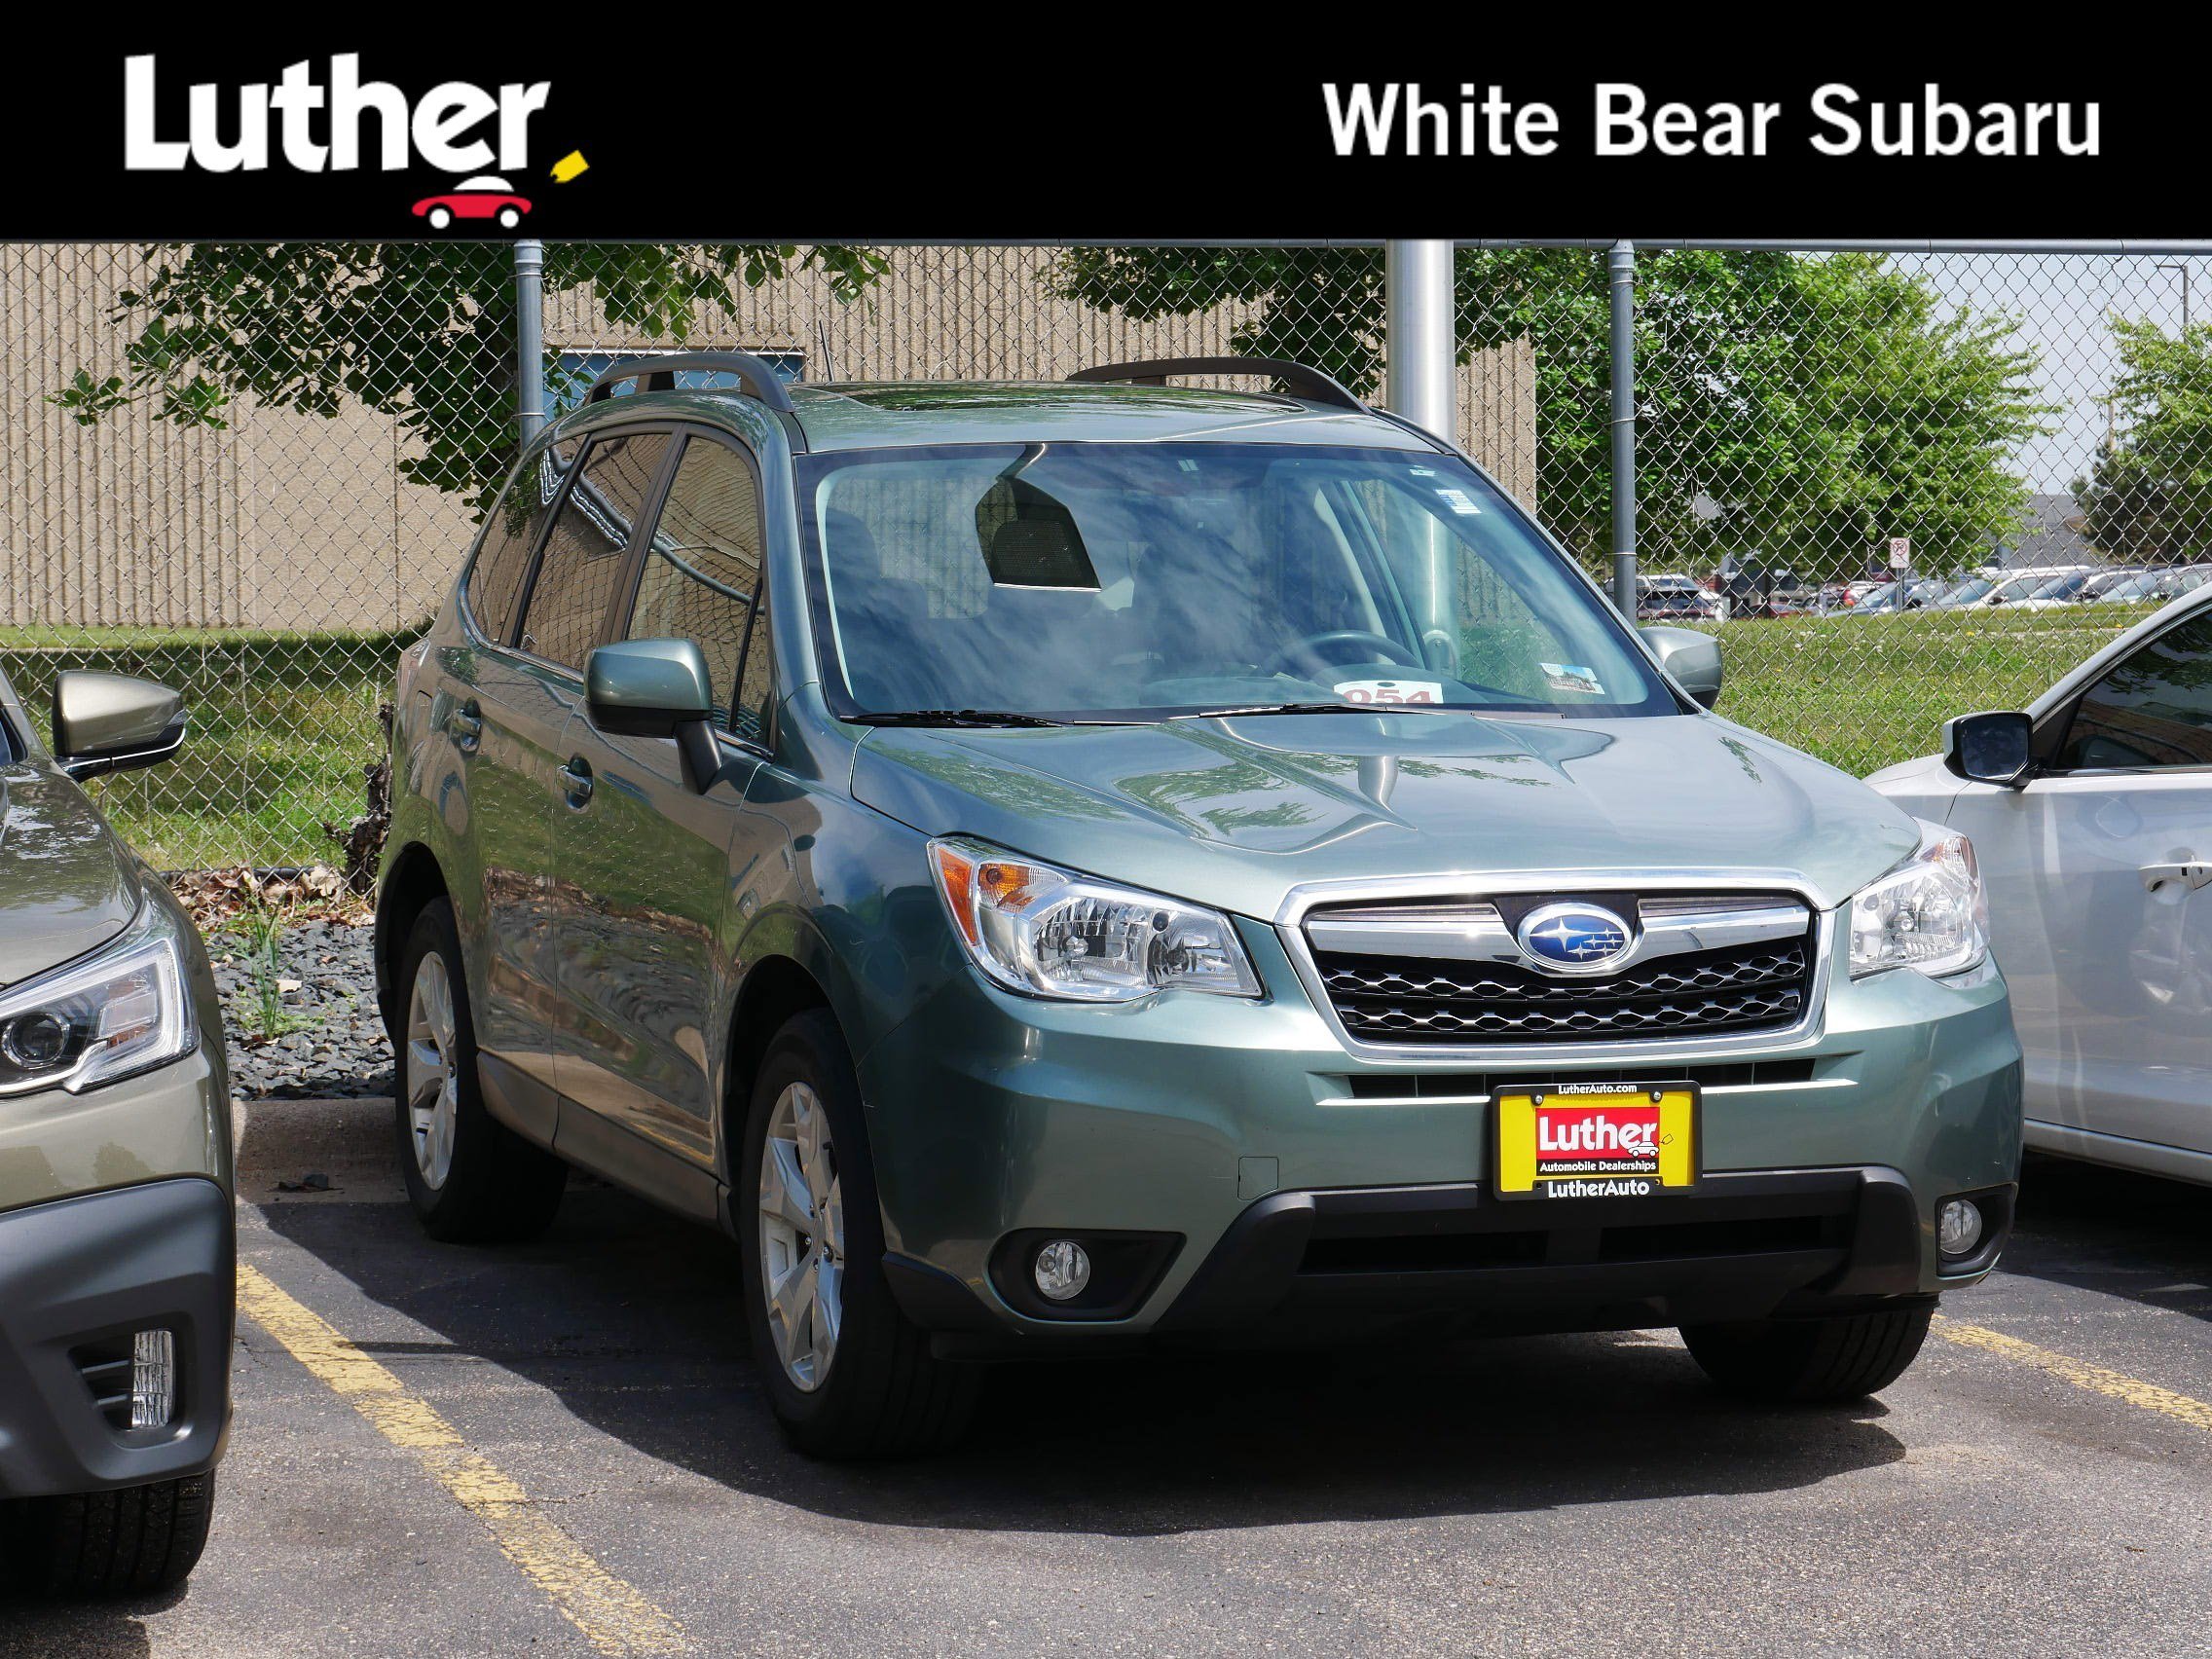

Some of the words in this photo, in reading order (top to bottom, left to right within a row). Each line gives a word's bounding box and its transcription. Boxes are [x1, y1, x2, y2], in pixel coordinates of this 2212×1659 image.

[1558, 1084, 1638, 1095] LutherAuto.com
[1538, 1115, 1658, 1151] Luther
[1539, 1161, 1597, 1172] Automobile
[1599, 1161, 1656, 1172] Dealerships
[1547, 1179, 1650, 1198] LutherAuto
